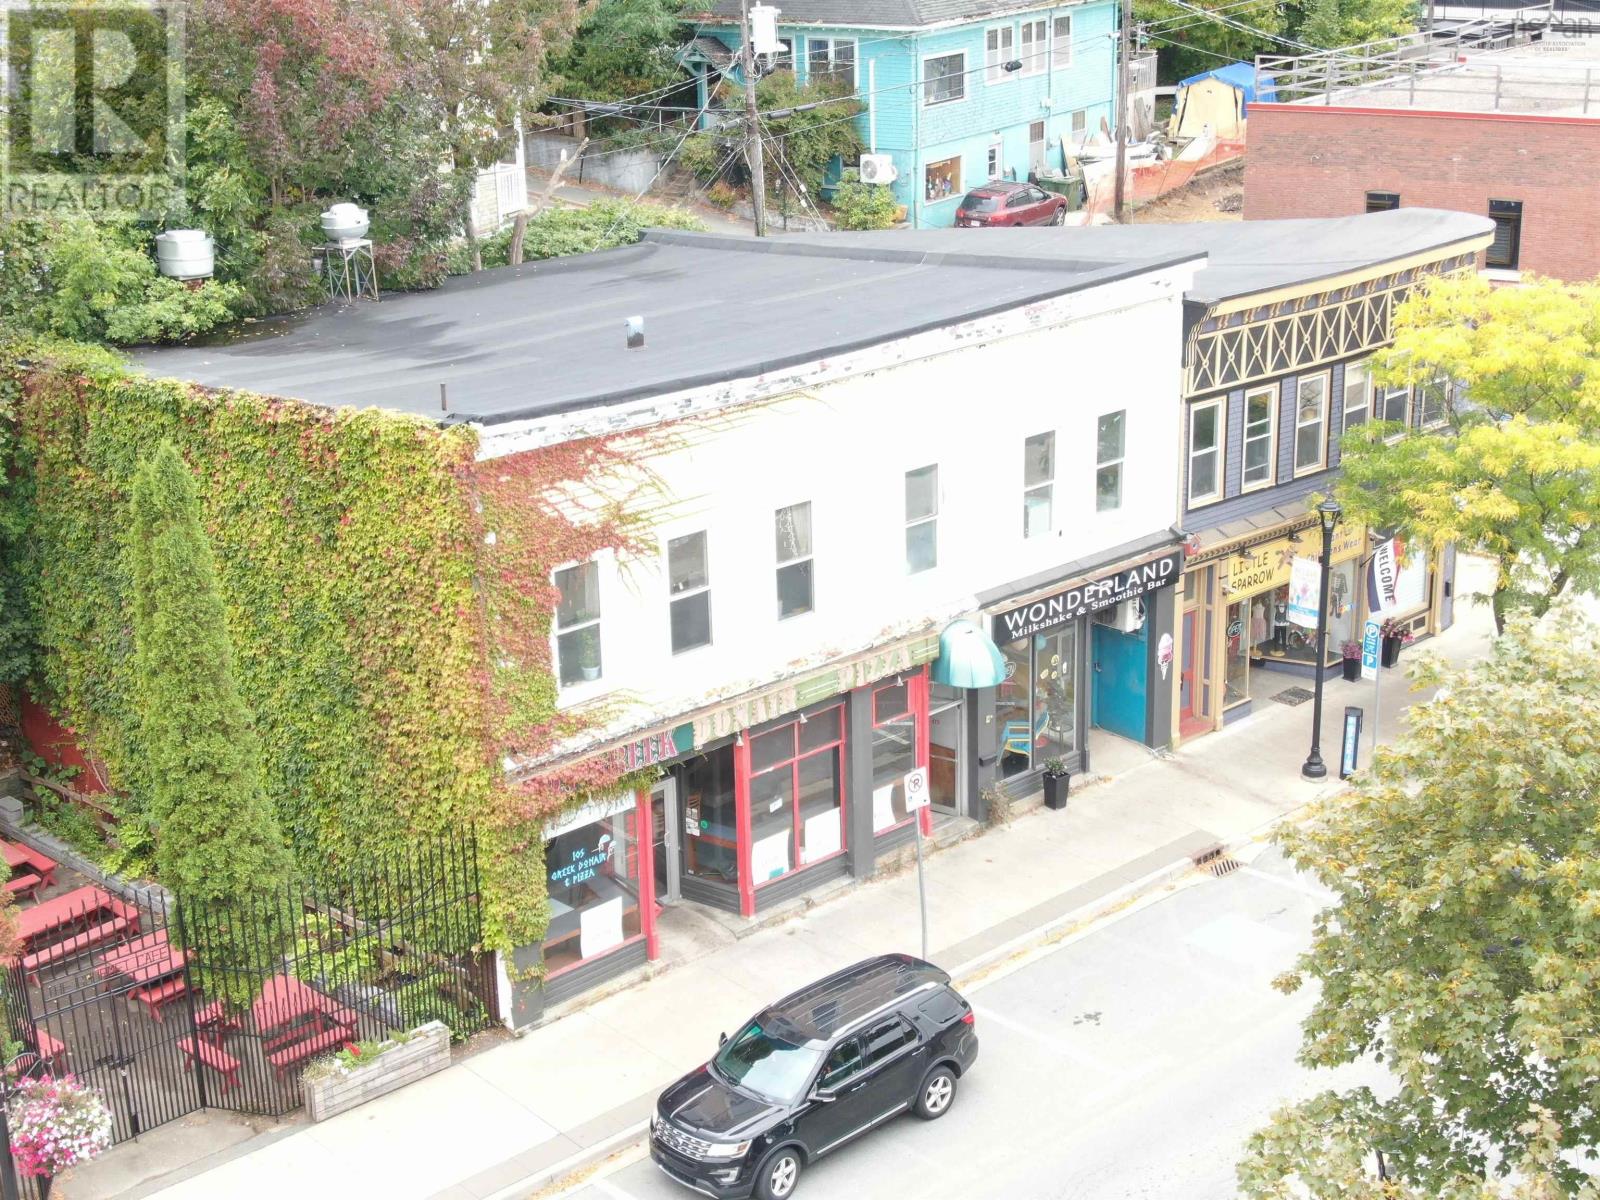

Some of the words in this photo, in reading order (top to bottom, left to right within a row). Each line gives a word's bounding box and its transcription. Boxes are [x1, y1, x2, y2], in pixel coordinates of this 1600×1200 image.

[1231, 567, 1274, 590] SPARROW
[1232, 551, 1269, 577] LITLE
[1379, 546, 1396, 602] WELCOME
[1005, 558, 1173, 630] WONDERLAND
[1011, 612, 1073, 640] Milkshake
[1076, 606, 1087, 616] &
[1147, 578, 1166, 590] Bar
[838, 645, 912, 693] PIZZA
[551, 864, 576, 881] GREEK
[572, 868, 595, 885] PIZZA
